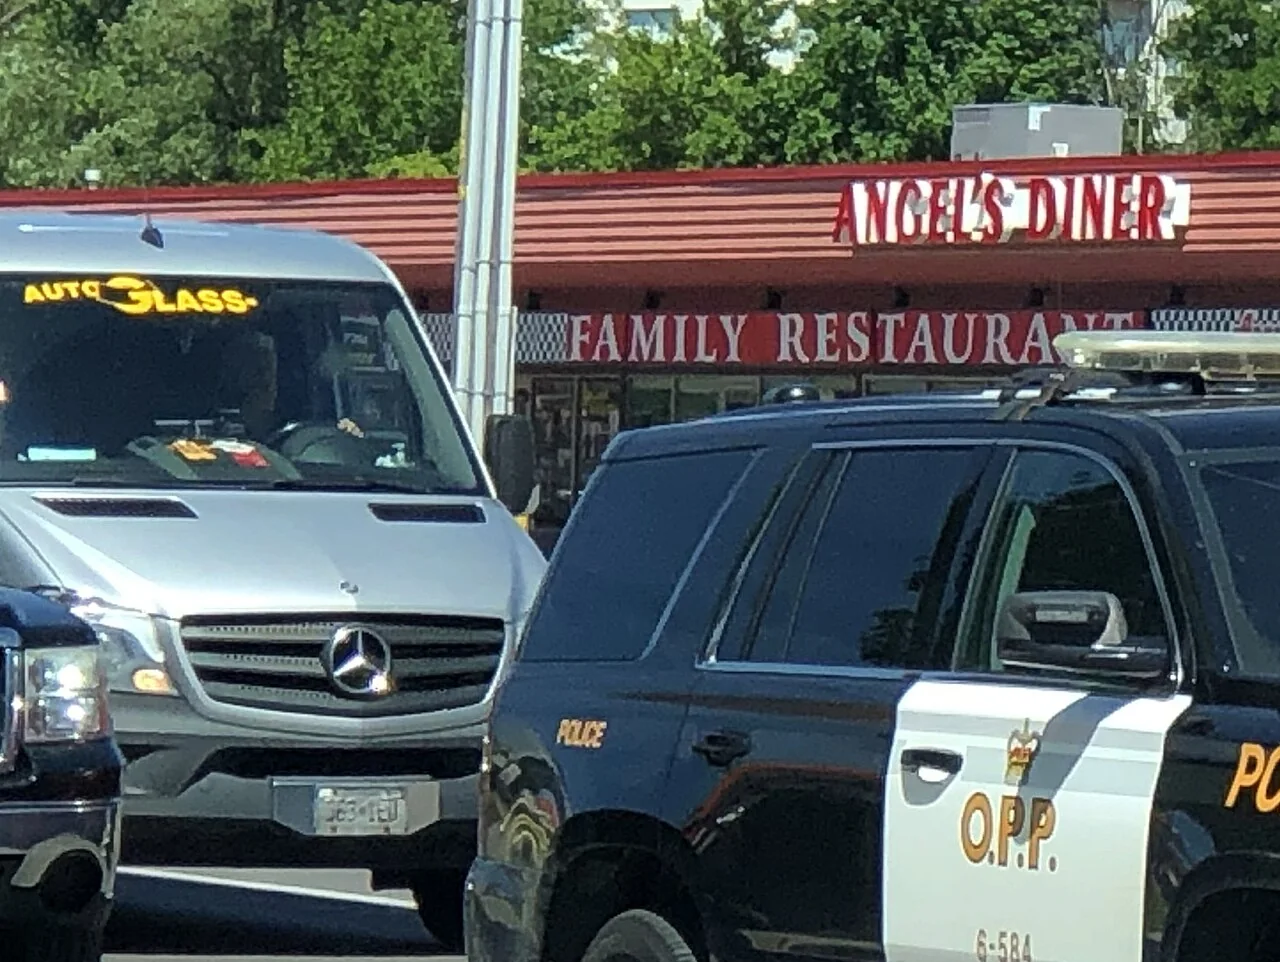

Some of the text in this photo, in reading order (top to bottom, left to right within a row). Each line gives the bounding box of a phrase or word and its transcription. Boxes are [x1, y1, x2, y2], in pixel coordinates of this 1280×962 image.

[833, 174, 1166, 244] ANGEL'S DINER
[24, 281, 100, 303] AUTO
[567, 313, 748, 363] FAMILY
[556, 719, 608, 749] POLICE
[960, 791, 1058, 873] O.P.P.
